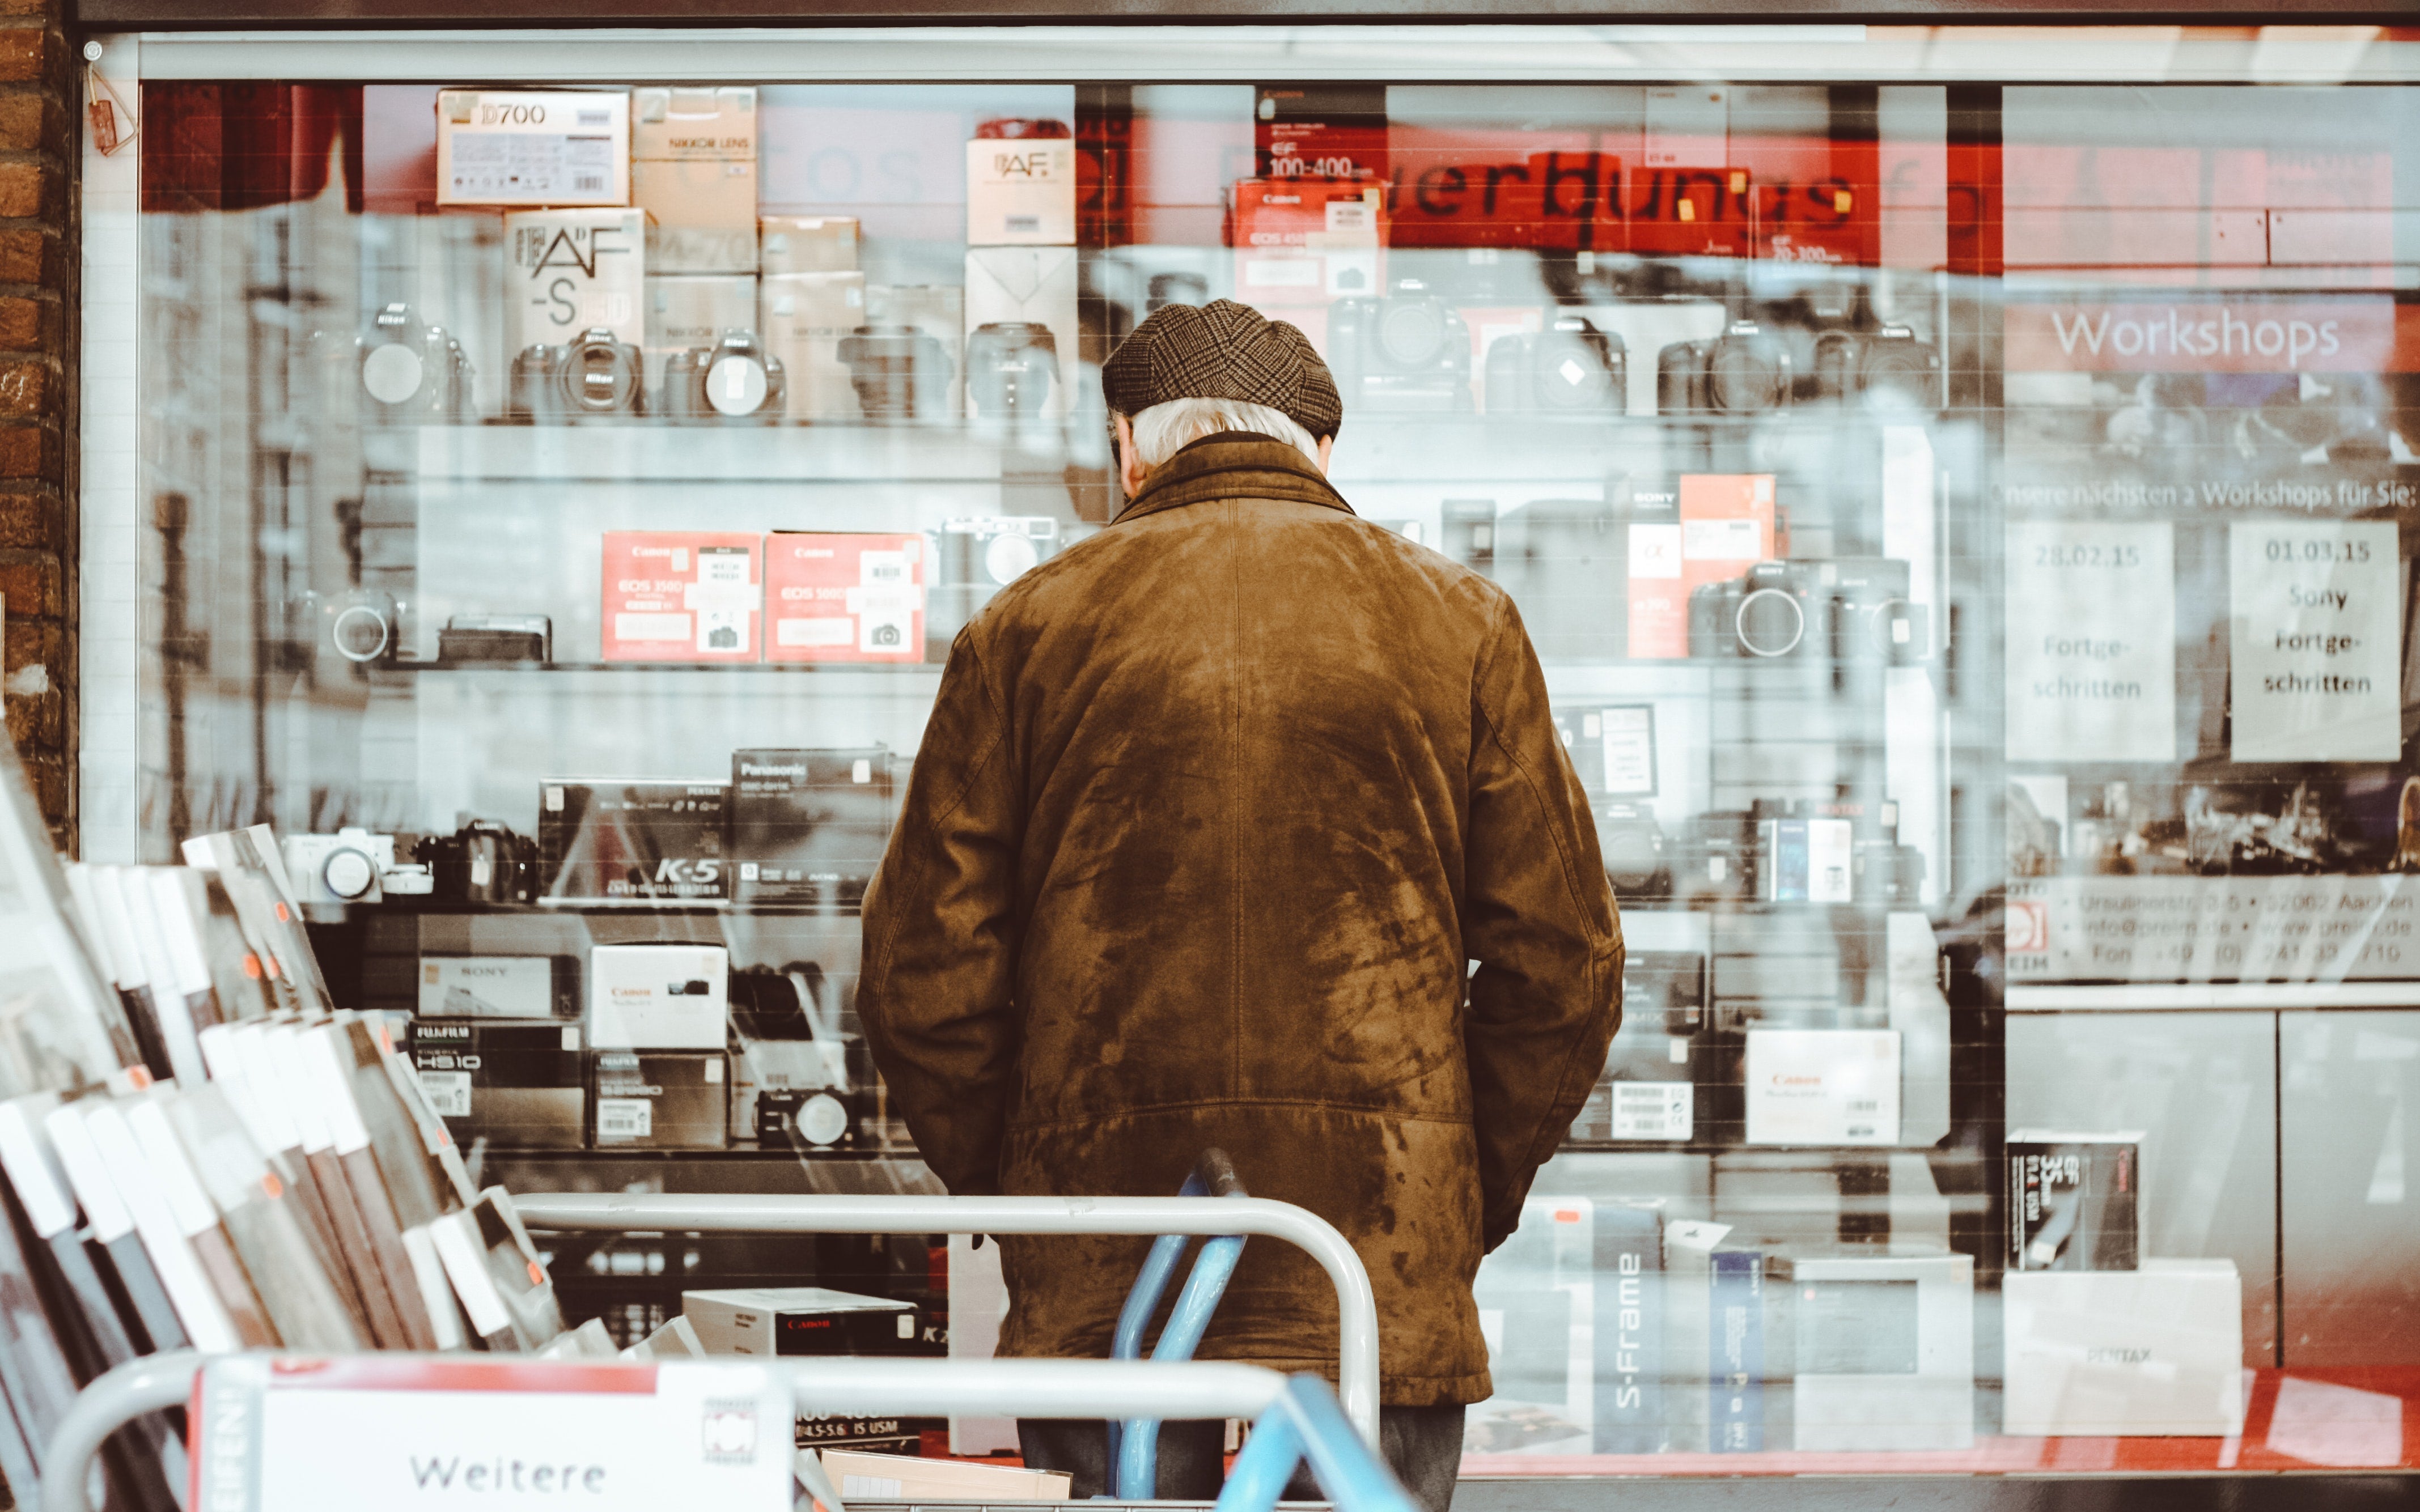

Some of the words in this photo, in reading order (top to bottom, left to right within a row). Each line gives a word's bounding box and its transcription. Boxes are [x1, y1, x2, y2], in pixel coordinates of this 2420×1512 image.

[481, 104, 545, 124] D700
[719, 139, 748, 148] LENS
[1262, 194, 1301, 204] Canon
[531, 228, 630, 278] AF
[378, 315, 405, 325] Nikon
[724, 338, 749, 347] Nikon
[2051, 307, 2340, 368] Workshops
[586, 373, 614, 384] Nikon
[1634, 493, 1675, 503] SONY
[2202, 481, 2332, 511] Workshops
[2337, 481, 2371, 507] für
[2376, 482, 2417, 507] Sie:
[632, 546, 671, 558] Canon
[794, 547, 833, 558] Canon
[2035, 545, 2140, 567] 28.02.15
[2266, 540, 2371, 563] 01.03.15
[618, 579, 650, 593] EOS
[781, 587, 813, 600] EOS
[2289, 584, 2348, 610] Sony
[2043, 636, 2131, 661] Fortge-
[2275, 630, 2362, 657] Fortge-
[2033, 677, 2141, 699] schritten
[2264, 673, 2371, 695] schritten
[740, 763, 807, 776] Panasonic
[655, 857, 721, 882] K-5
[611, 987, 651, 997] Canon
[417, 1027, 469, 1038] FUJIFILM
[417, 1055, 482, 1069] HS10
[1772, 1073, 1821, 1086] Canon
[2063, 1155, 2079, 1185] EF
[787, 1319, 830, 1330] Canon
[1616, 1252, 1641, 1409] S-Frame
[2088, 1348, 2152, 1362] PENTAX
[854, 1422, 866, 1435] IS
[869, 1420, 898, 1434] USM
[409, 1454, 607, 1494] Weitere
